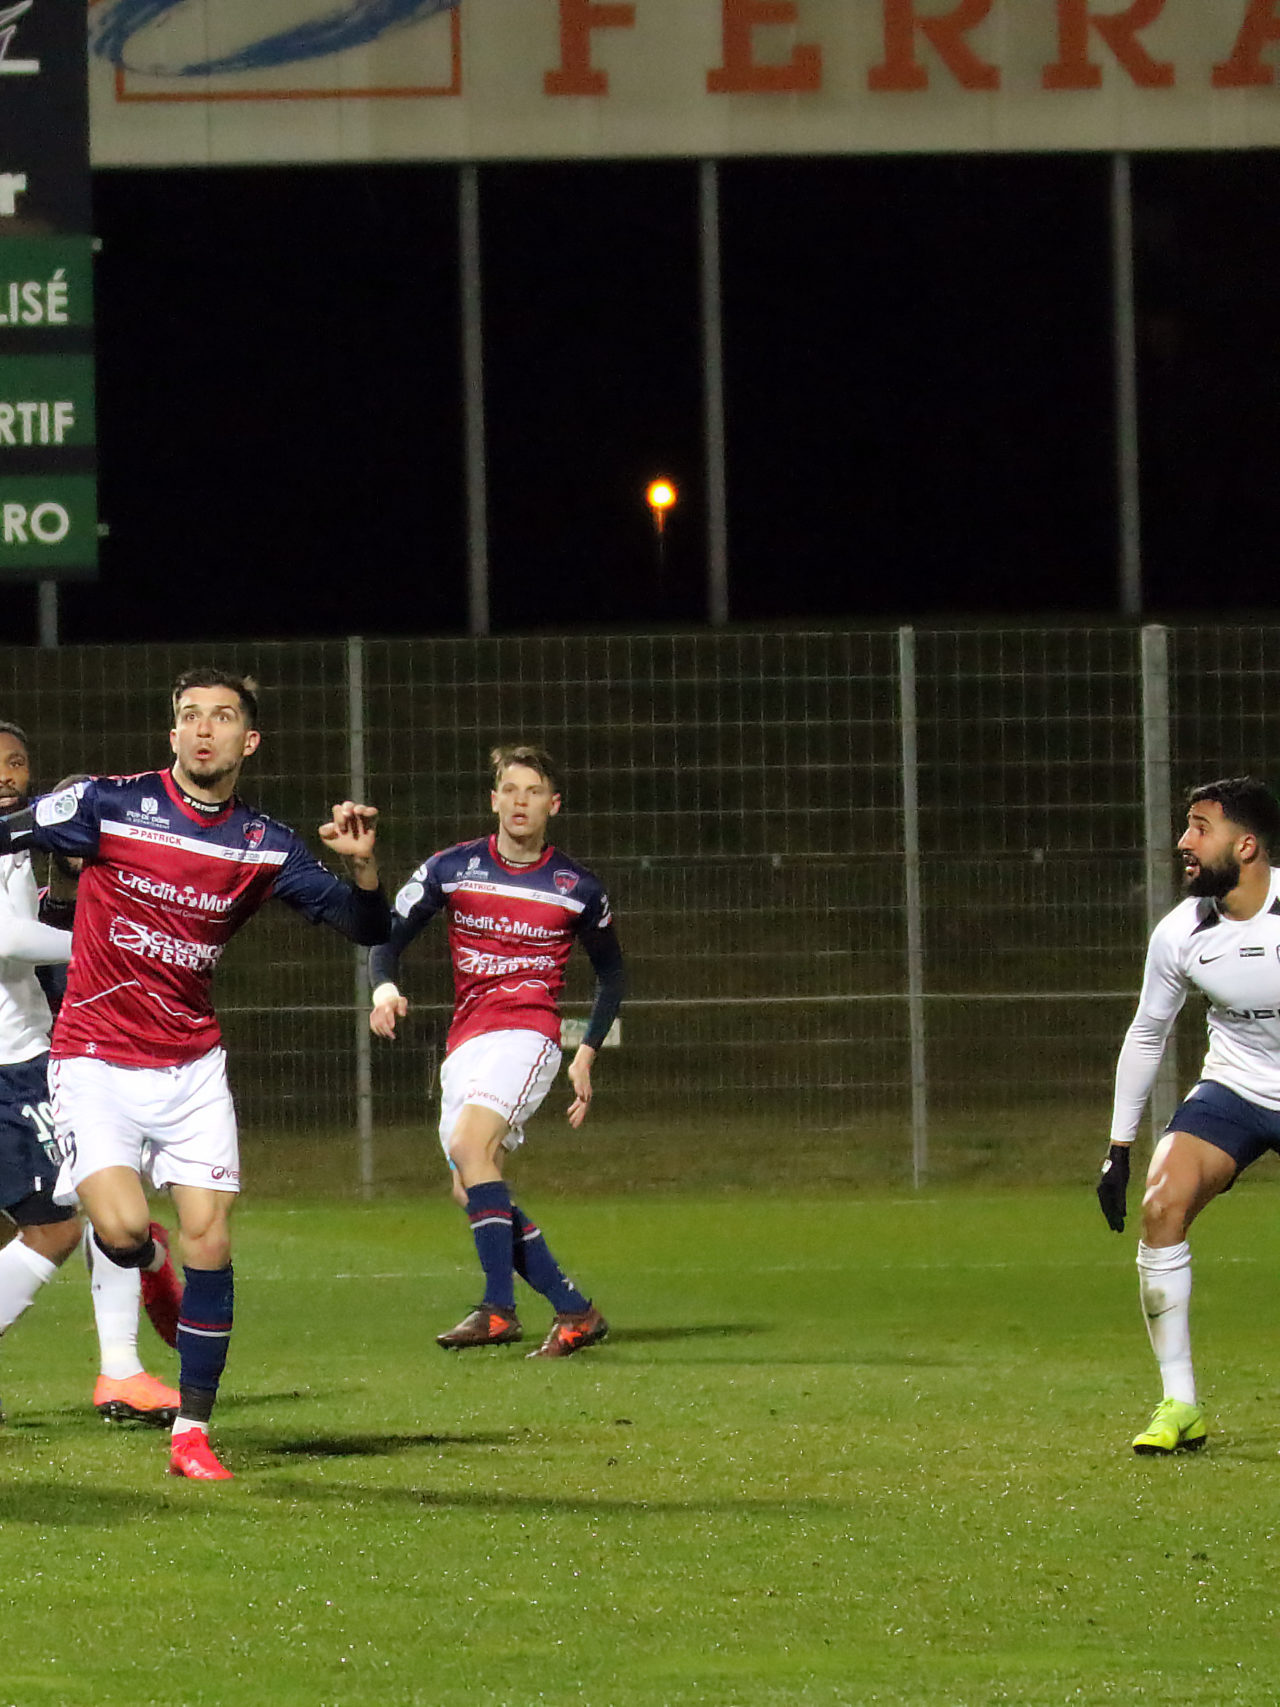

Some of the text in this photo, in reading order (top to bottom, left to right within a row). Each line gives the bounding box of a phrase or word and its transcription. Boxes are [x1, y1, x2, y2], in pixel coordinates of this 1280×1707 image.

[140, 830, 183, 846] PATRICK
[117, 870, 178, 902] Crédit
[454, 910, 494, 930] Crédit
